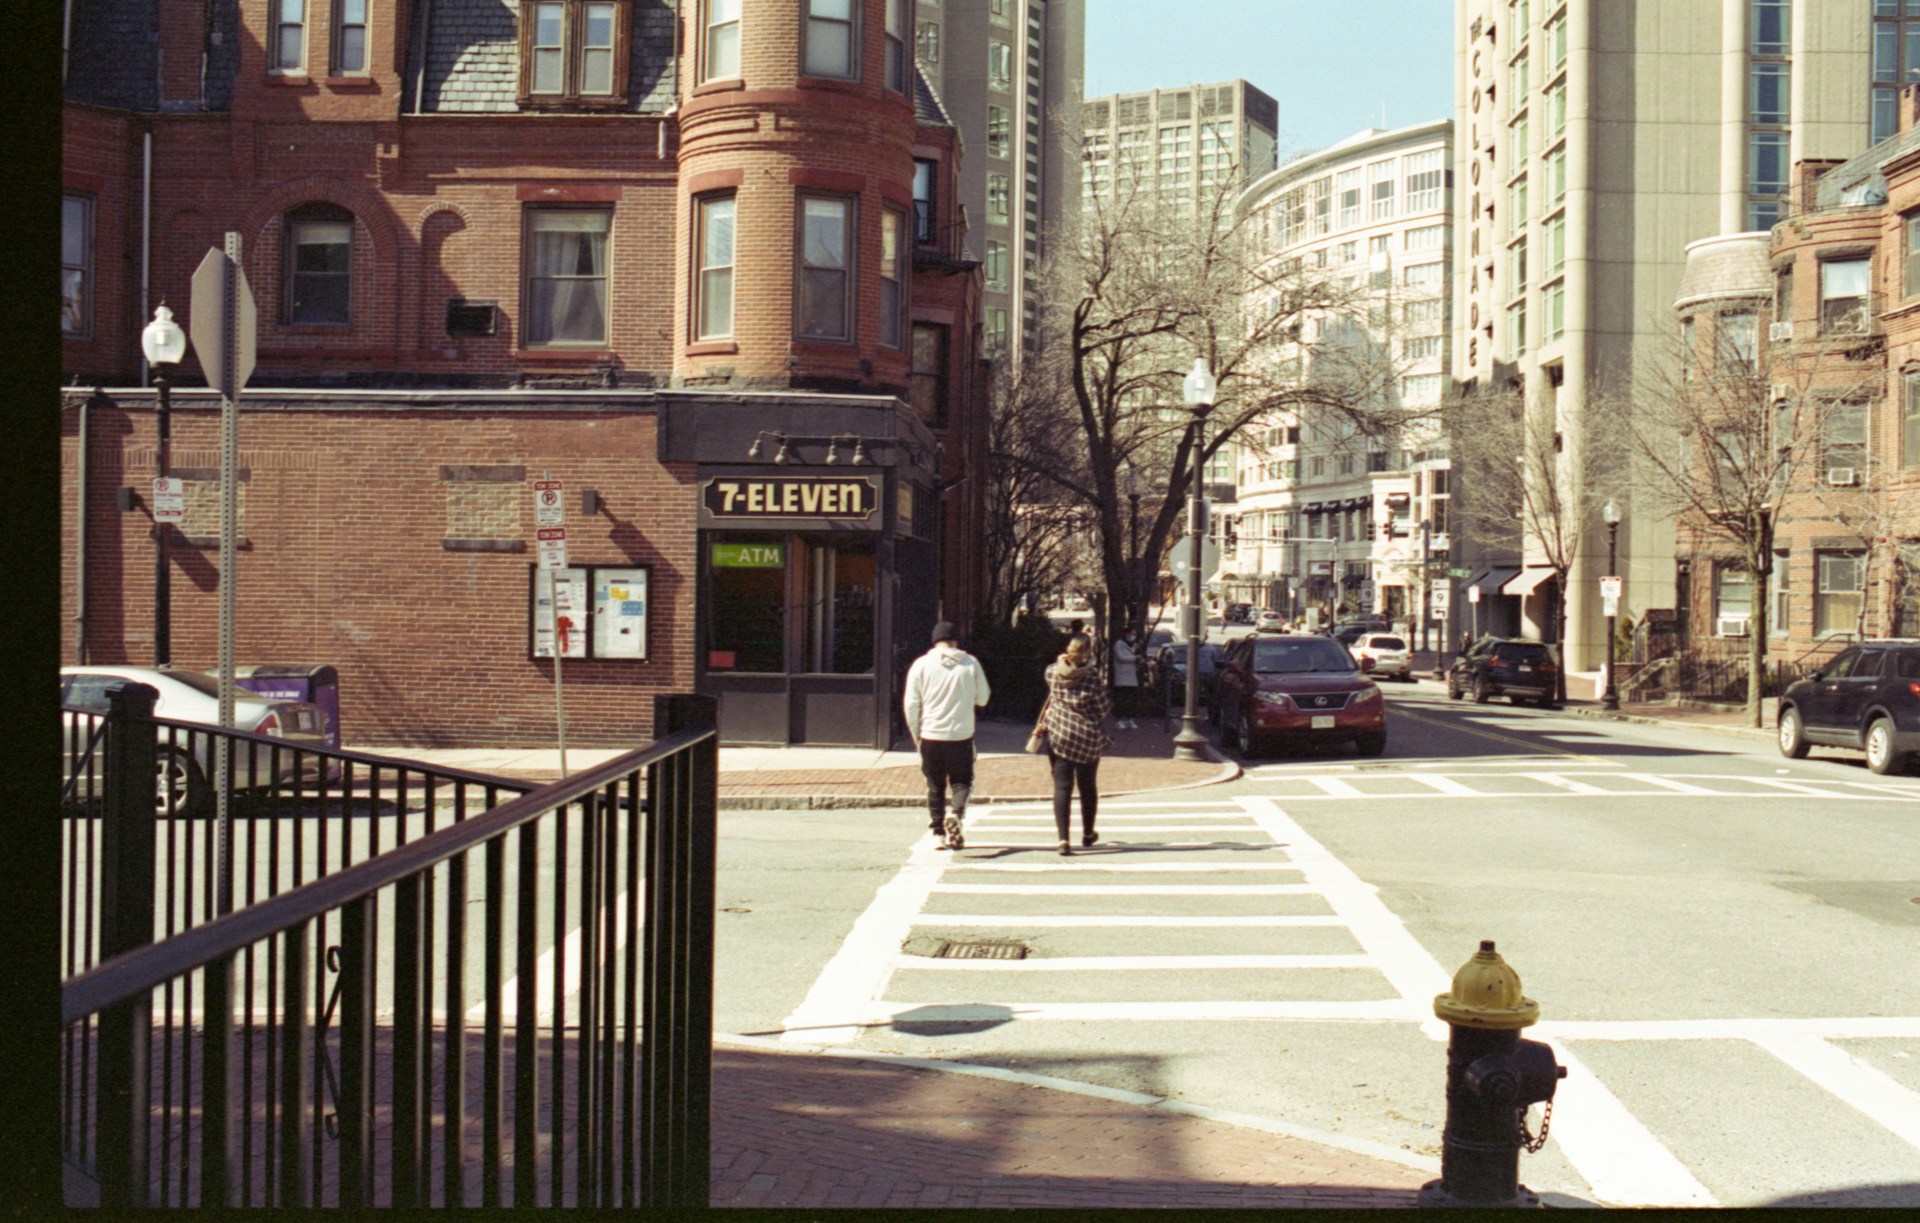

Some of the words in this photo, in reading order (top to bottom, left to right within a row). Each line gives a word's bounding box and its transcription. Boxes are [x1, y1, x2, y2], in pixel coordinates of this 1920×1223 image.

[1470, 50, 1481, 367] COLONNADE
[738, 548, 780, 563] ATM
[1437, 593, 1444, 602] 9
